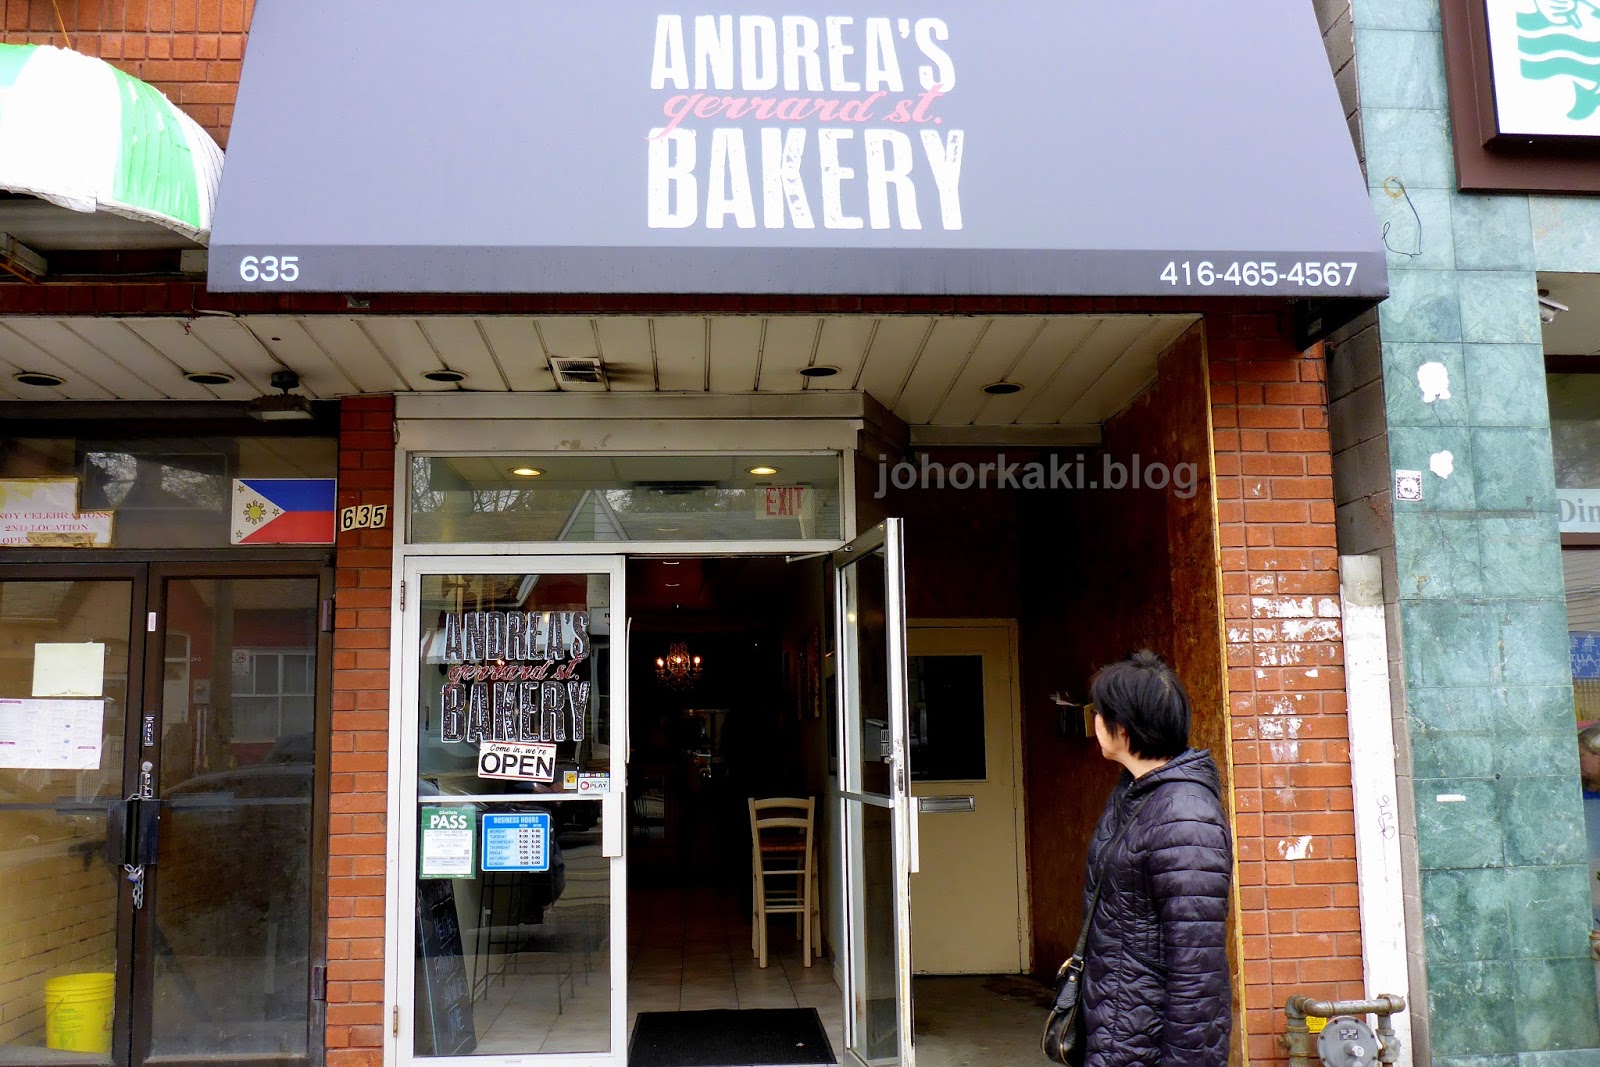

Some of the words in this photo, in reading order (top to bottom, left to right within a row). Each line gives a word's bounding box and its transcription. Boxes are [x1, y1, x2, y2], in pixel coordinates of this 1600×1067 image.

[650, 14, 956, 93] ANDREA'S
[644, 90, 888, 140] gerrard
[884, 83, 944, 125] st.
[648, 127, 965, 230] BAKERY
[240, 255, 299, 282] 635
[1159, 261, 1358, 287] 416-465-4567
[766, 487, 804, 516] EXIT
[5, 524, 27, 532] 2ND
[31, 523, 88, 532] LOCATION
[343, 506, 385, 529] 635
[443, 611, 590, 661] ANDREA'S
[440, 660, 554, 695] gerrard
[550, 653, 582, 681] st.
[441, 681, 591, 743] BAKERY
[489, 744, 511, 752] Come
[525, 745, 547, 755] we're
[480, 752, 554, 777] OPEN
[430, 815, 468, 829] PASS
[493, 816, 520, 824] BUSINESS
[520, 816, 539, 824] HOURS
